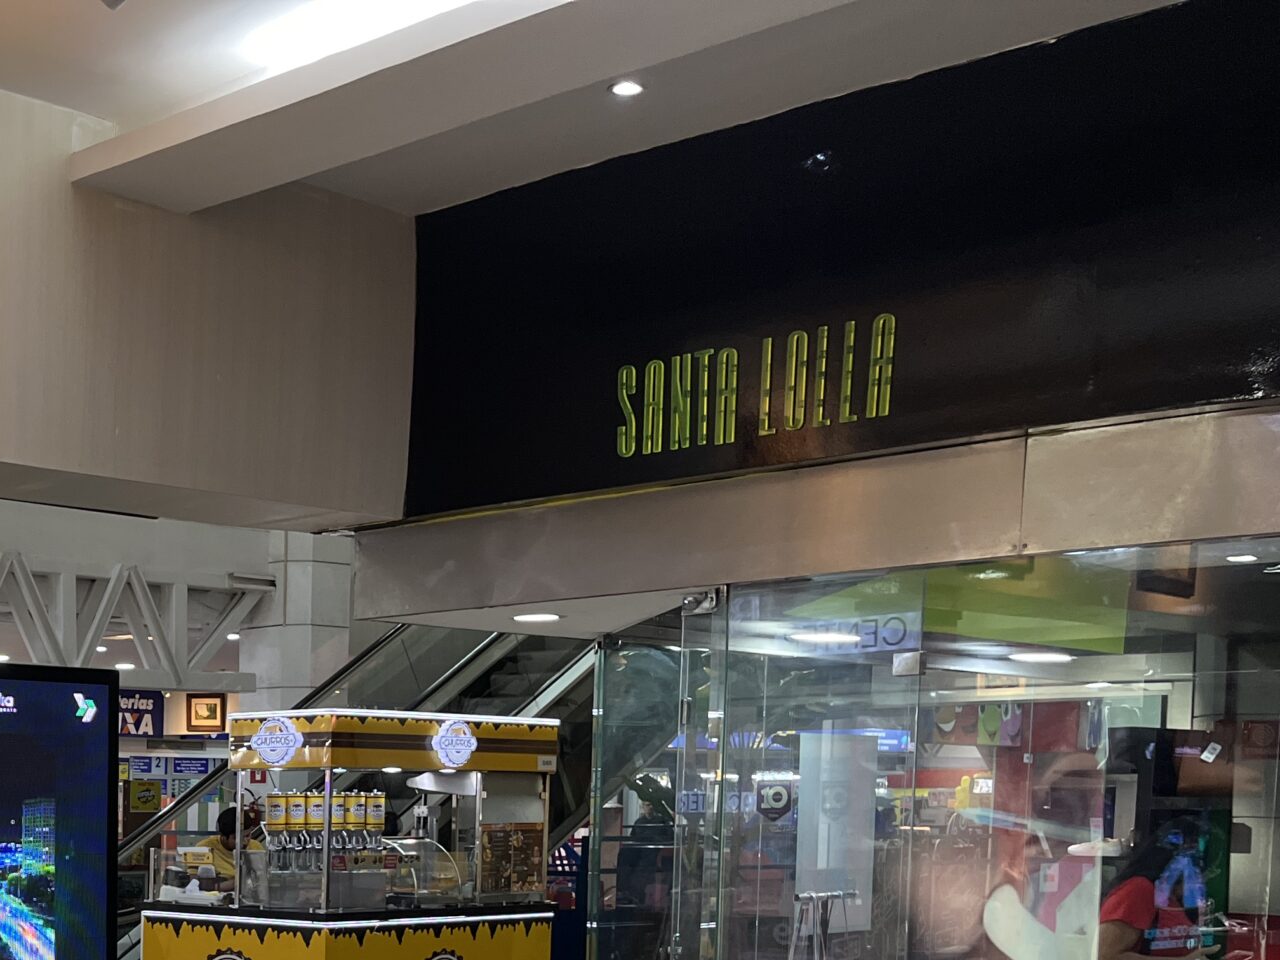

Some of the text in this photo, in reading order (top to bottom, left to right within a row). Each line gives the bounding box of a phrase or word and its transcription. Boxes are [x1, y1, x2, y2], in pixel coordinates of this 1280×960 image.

[617, 313, 896, 458] SANTA LOLLA
[256, 735, 290, 747] CHURROS
[442, 737, 473, 748] CHURROS
